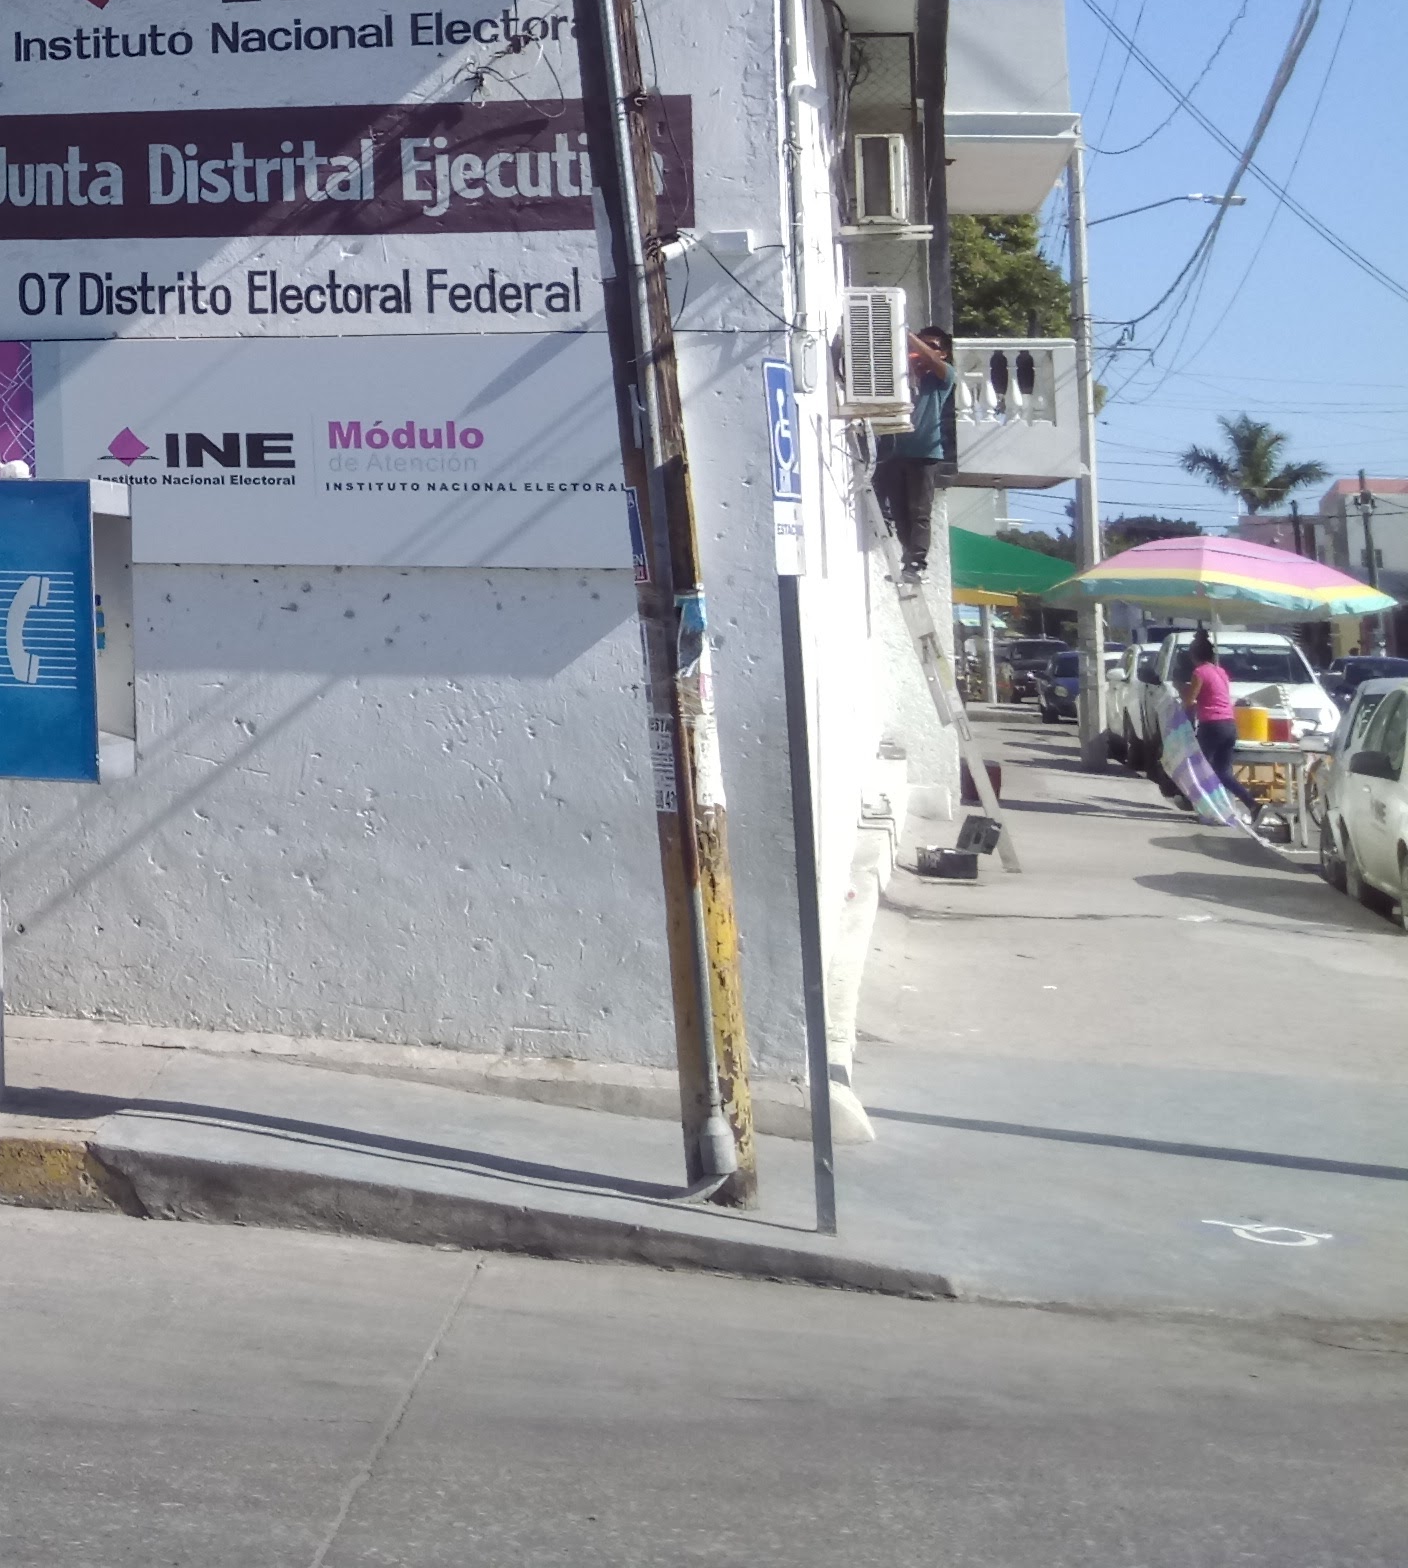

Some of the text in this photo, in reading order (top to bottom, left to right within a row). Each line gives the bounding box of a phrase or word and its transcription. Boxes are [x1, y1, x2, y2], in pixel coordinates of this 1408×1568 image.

[13, 9, 578, 62] Instituto Nacional Elector
[148, 138, 374, 205] Distrital
[400, 132, 664, 218] Ejecuti
[18, 266, 582, 316] 07 Distrito Electoral Federal
[165, 432, 296, 468] INE
[328, 420, 484, 450] Módulo
[329, 452, 357, 473] de
[366, 450, 478, 473] Atención
[162, 474, 225, 485] Nacional
[230, 474, 296, 485] Electoral
[325, 482, 627, 492] INSTITUTO NACIONAL ELECTORAL
